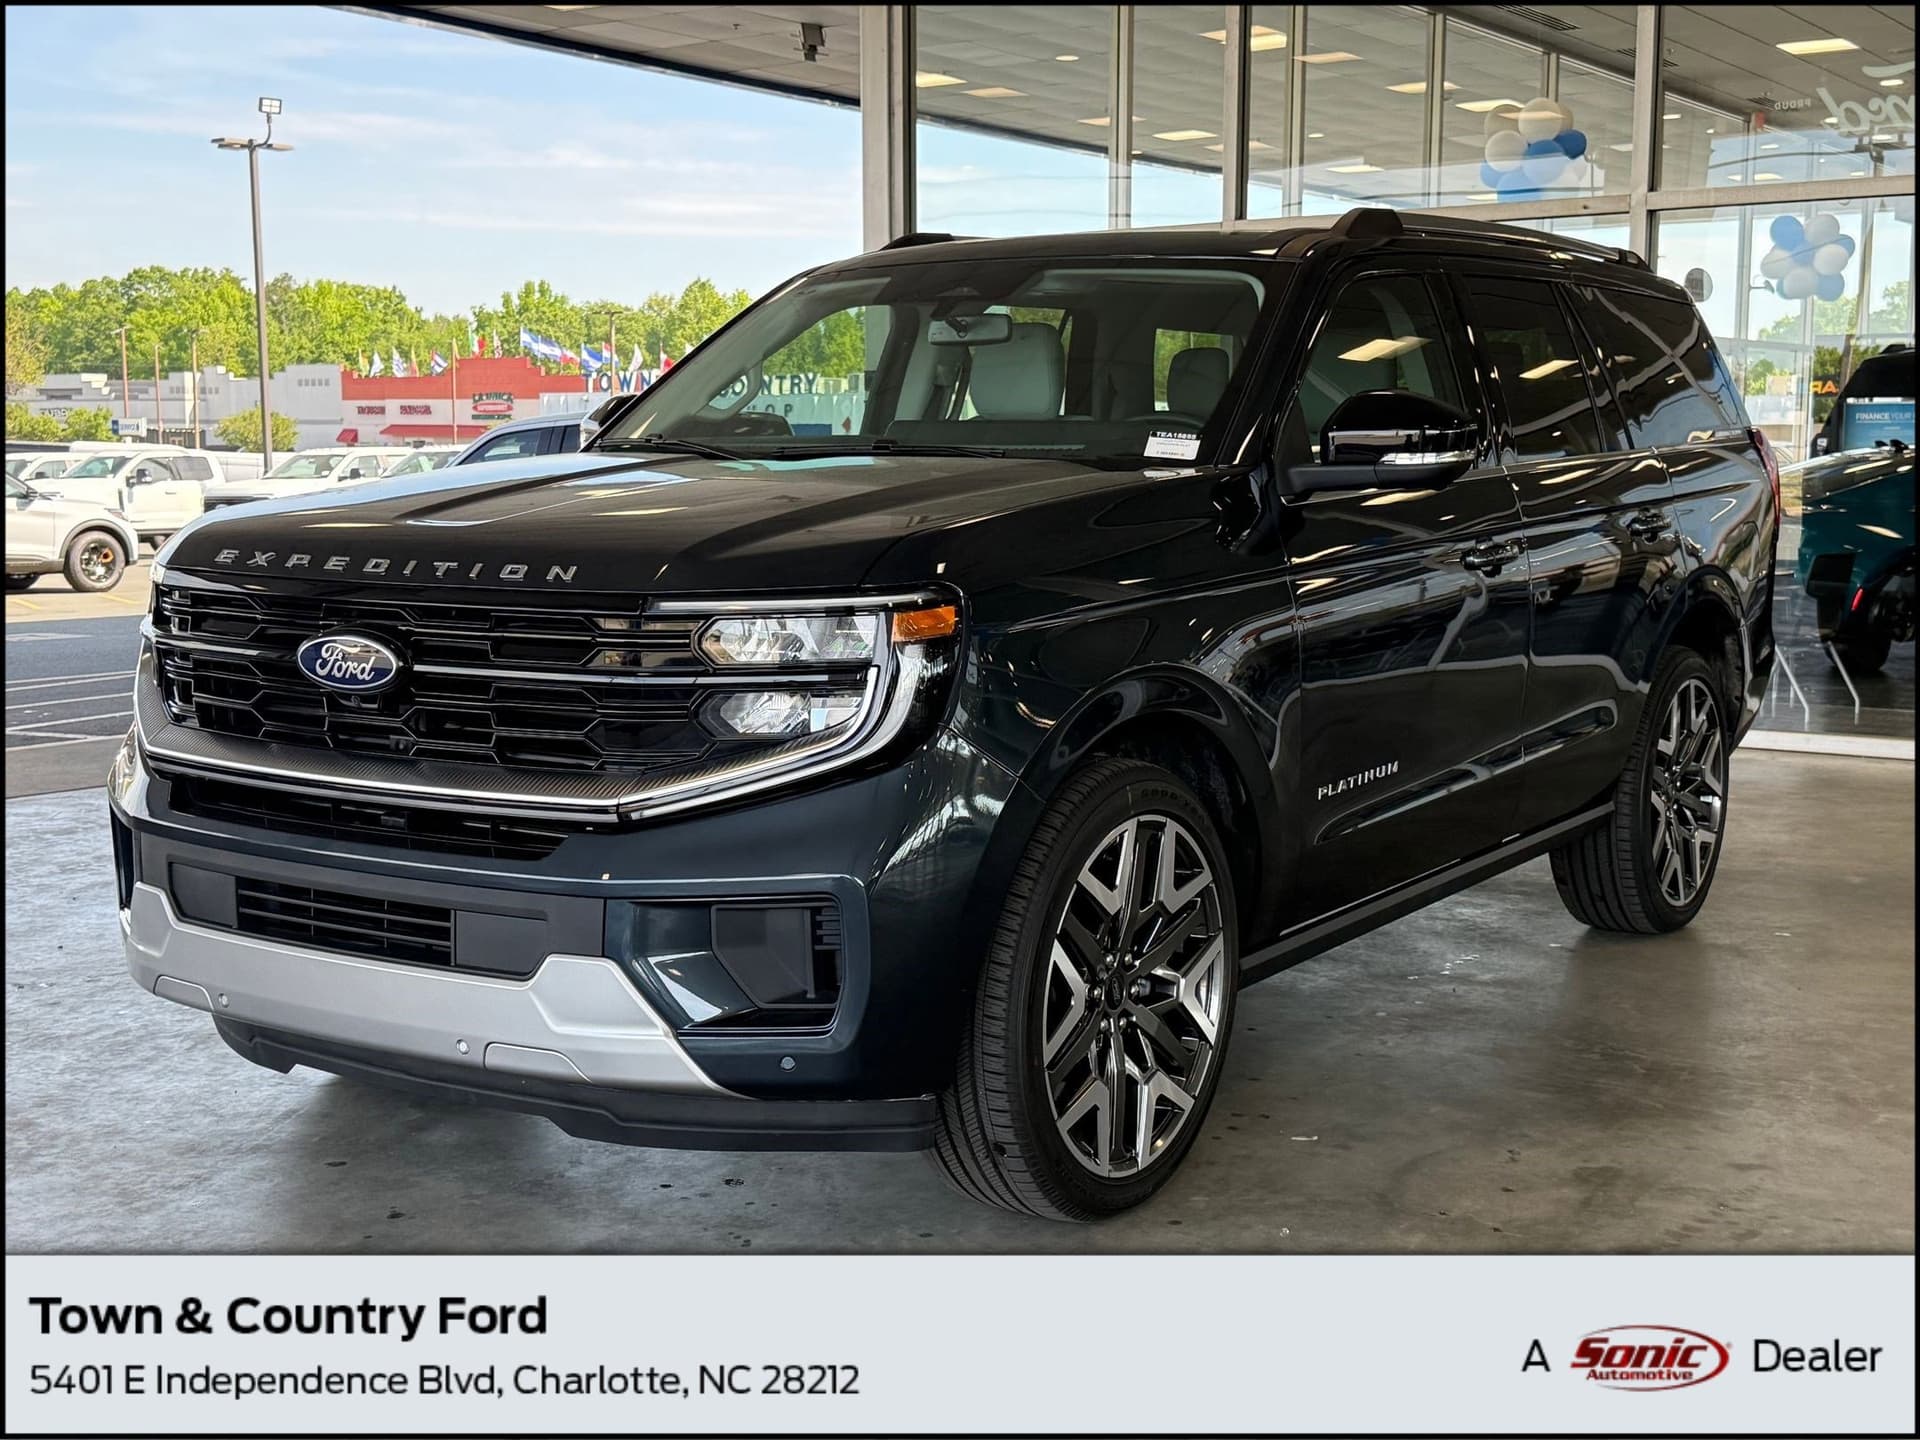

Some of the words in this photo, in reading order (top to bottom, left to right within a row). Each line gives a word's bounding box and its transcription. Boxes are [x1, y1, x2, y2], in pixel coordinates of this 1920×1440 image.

[584, 373, 654, 393] TOWN
[720, 373, 818, 397] ONTRY
[1855, 412, 1889, 420] FINANCE
[214, 549, 577, 582] EXPEDITION
[315, 643, 375, 682] Ford
[1318, 760, 1399, 801] PLATINUM
